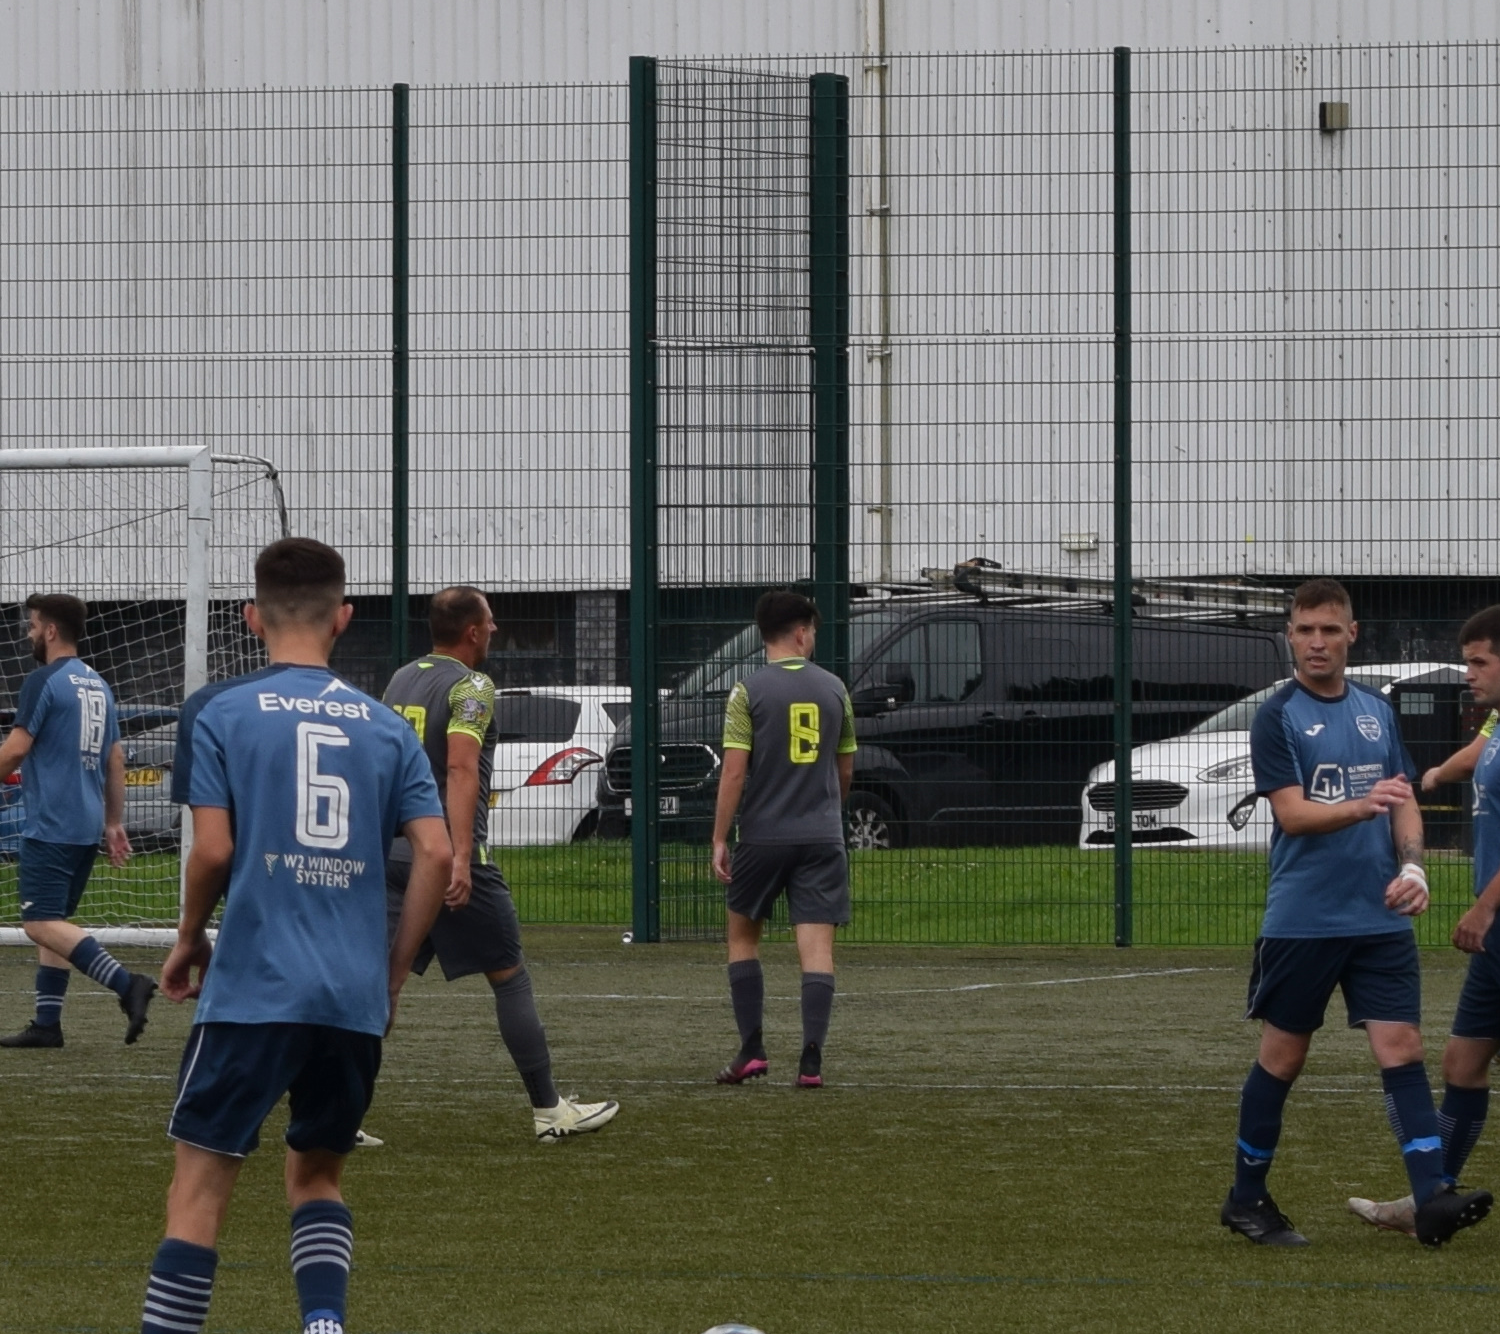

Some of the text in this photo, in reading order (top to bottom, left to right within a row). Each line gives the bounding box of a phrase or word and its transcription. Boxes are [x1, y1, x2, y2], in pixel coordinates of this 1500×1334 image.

[77, 686, 107, 754] 18
[258, 692, 371, 721] Everest
[789, 702, 820, 764] 8
[295, 721, 350, 850] 6
[284, 854, 366, 877] W2 WINDOW
[296, 869, 350, 889] SYSTEMS
